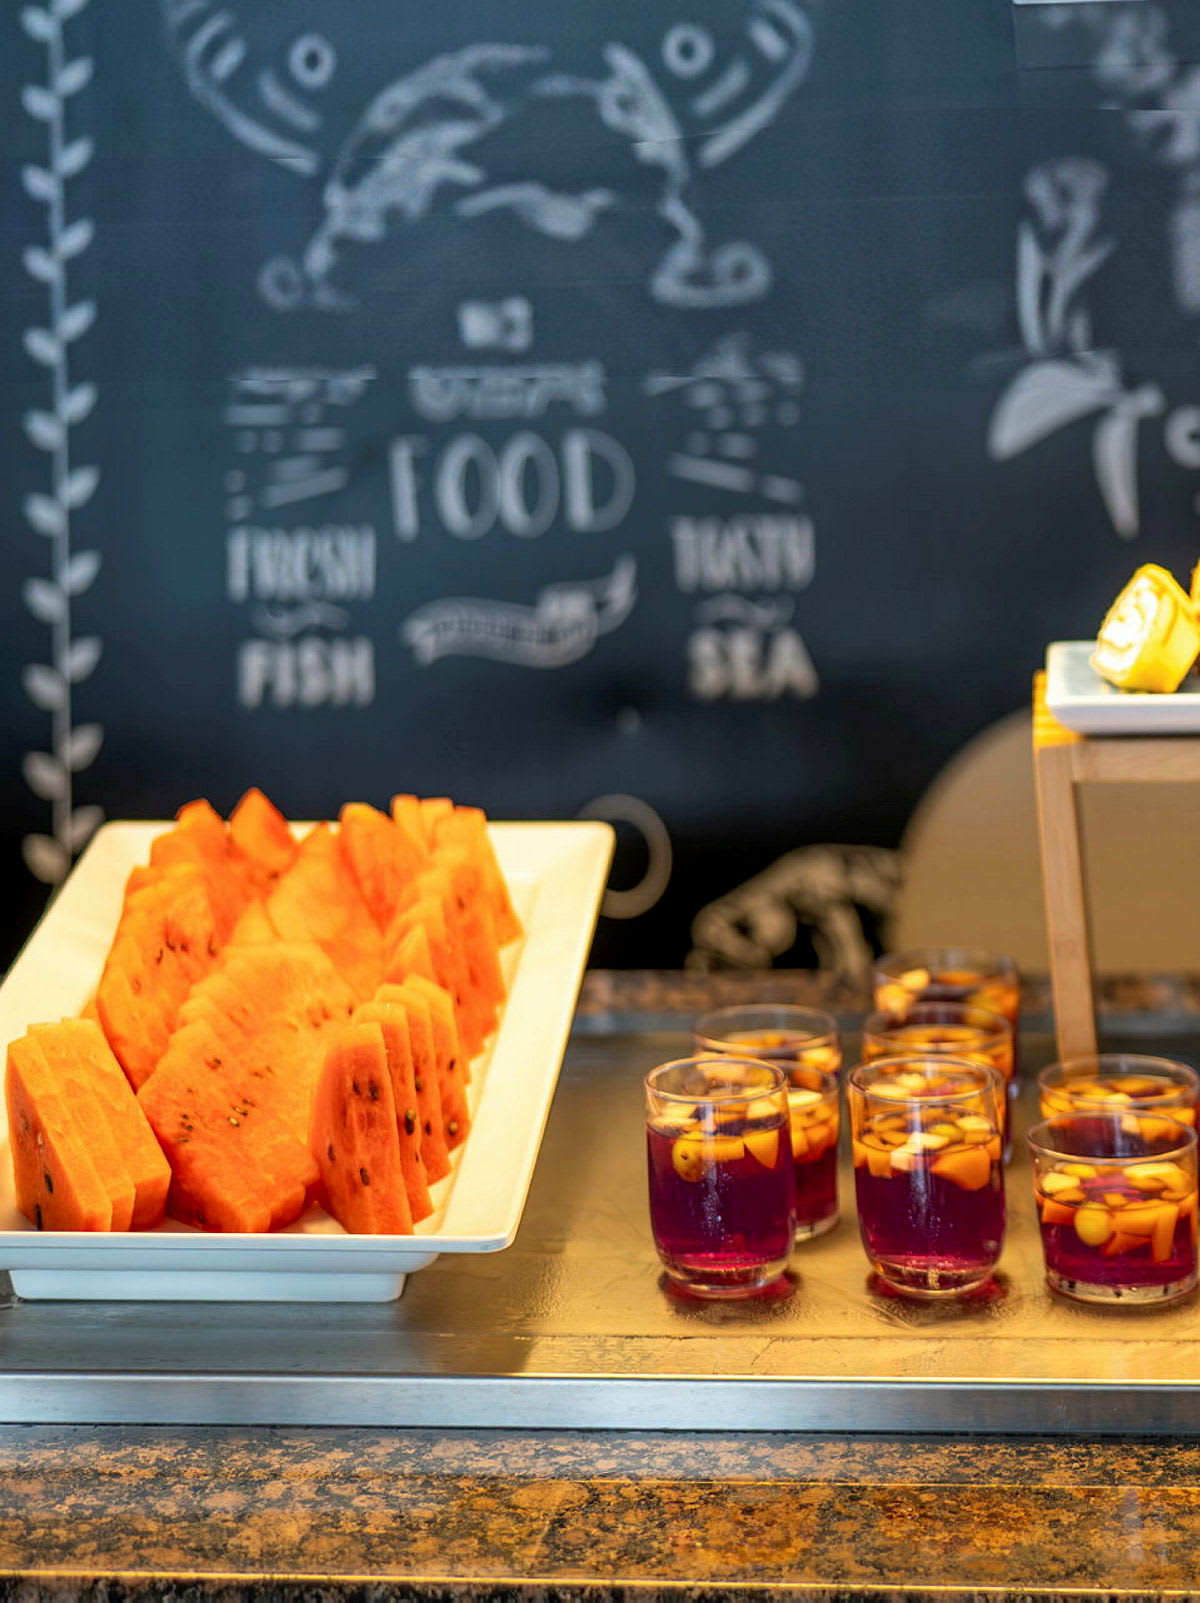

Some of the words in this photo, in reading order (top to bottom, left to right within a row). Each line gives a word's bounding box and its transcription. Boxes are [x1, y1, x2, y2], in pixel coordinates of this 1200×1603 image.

[388, 428, 638, 542] FOOD
[238, 636, 376, 708] FISH
[688, 627, 821, 700] SEA
